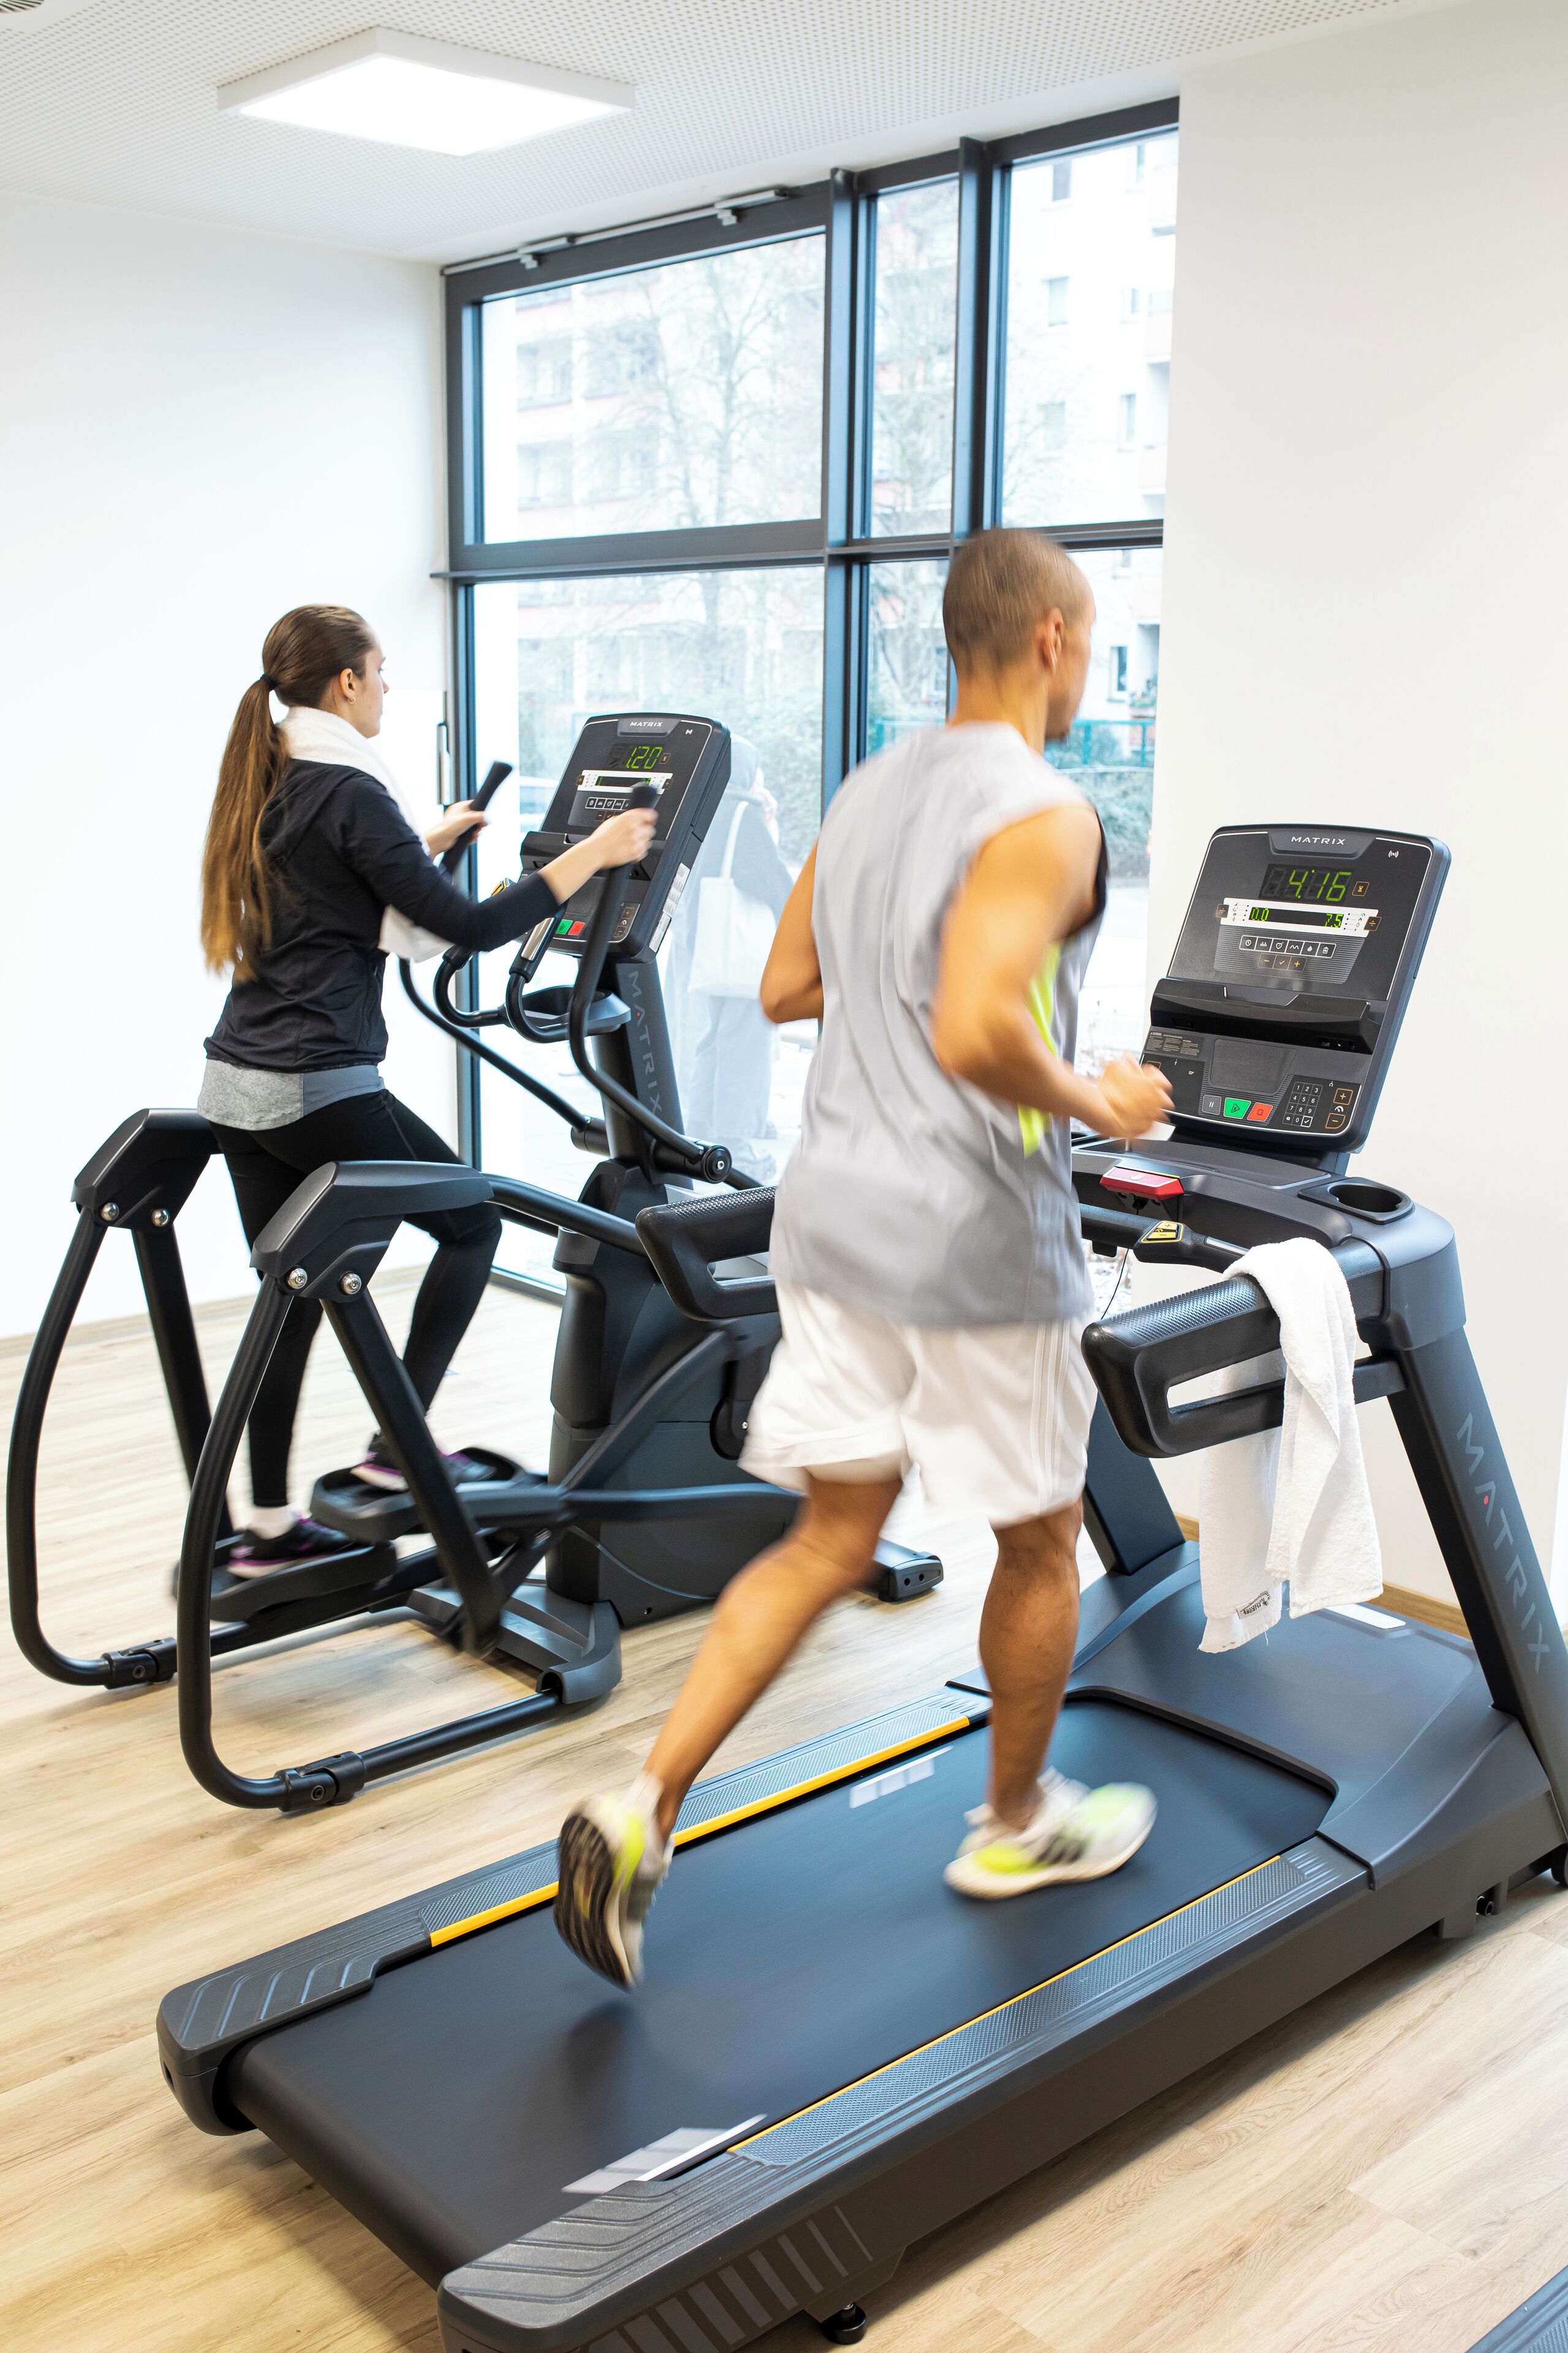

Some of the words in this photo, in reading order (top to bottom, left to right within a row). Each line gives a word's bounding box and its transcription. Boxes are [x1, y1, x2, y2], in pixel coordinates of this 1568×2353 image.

[1291, 836, 1346, 845] MATRIX
[1251, 907, 1270, 922] 0.0
[1324, 914, 1343, 928] 7.5
[629, 971, 662, 1114] MATRIX
[1456, 1412, 1550, 1675] MATRIX
